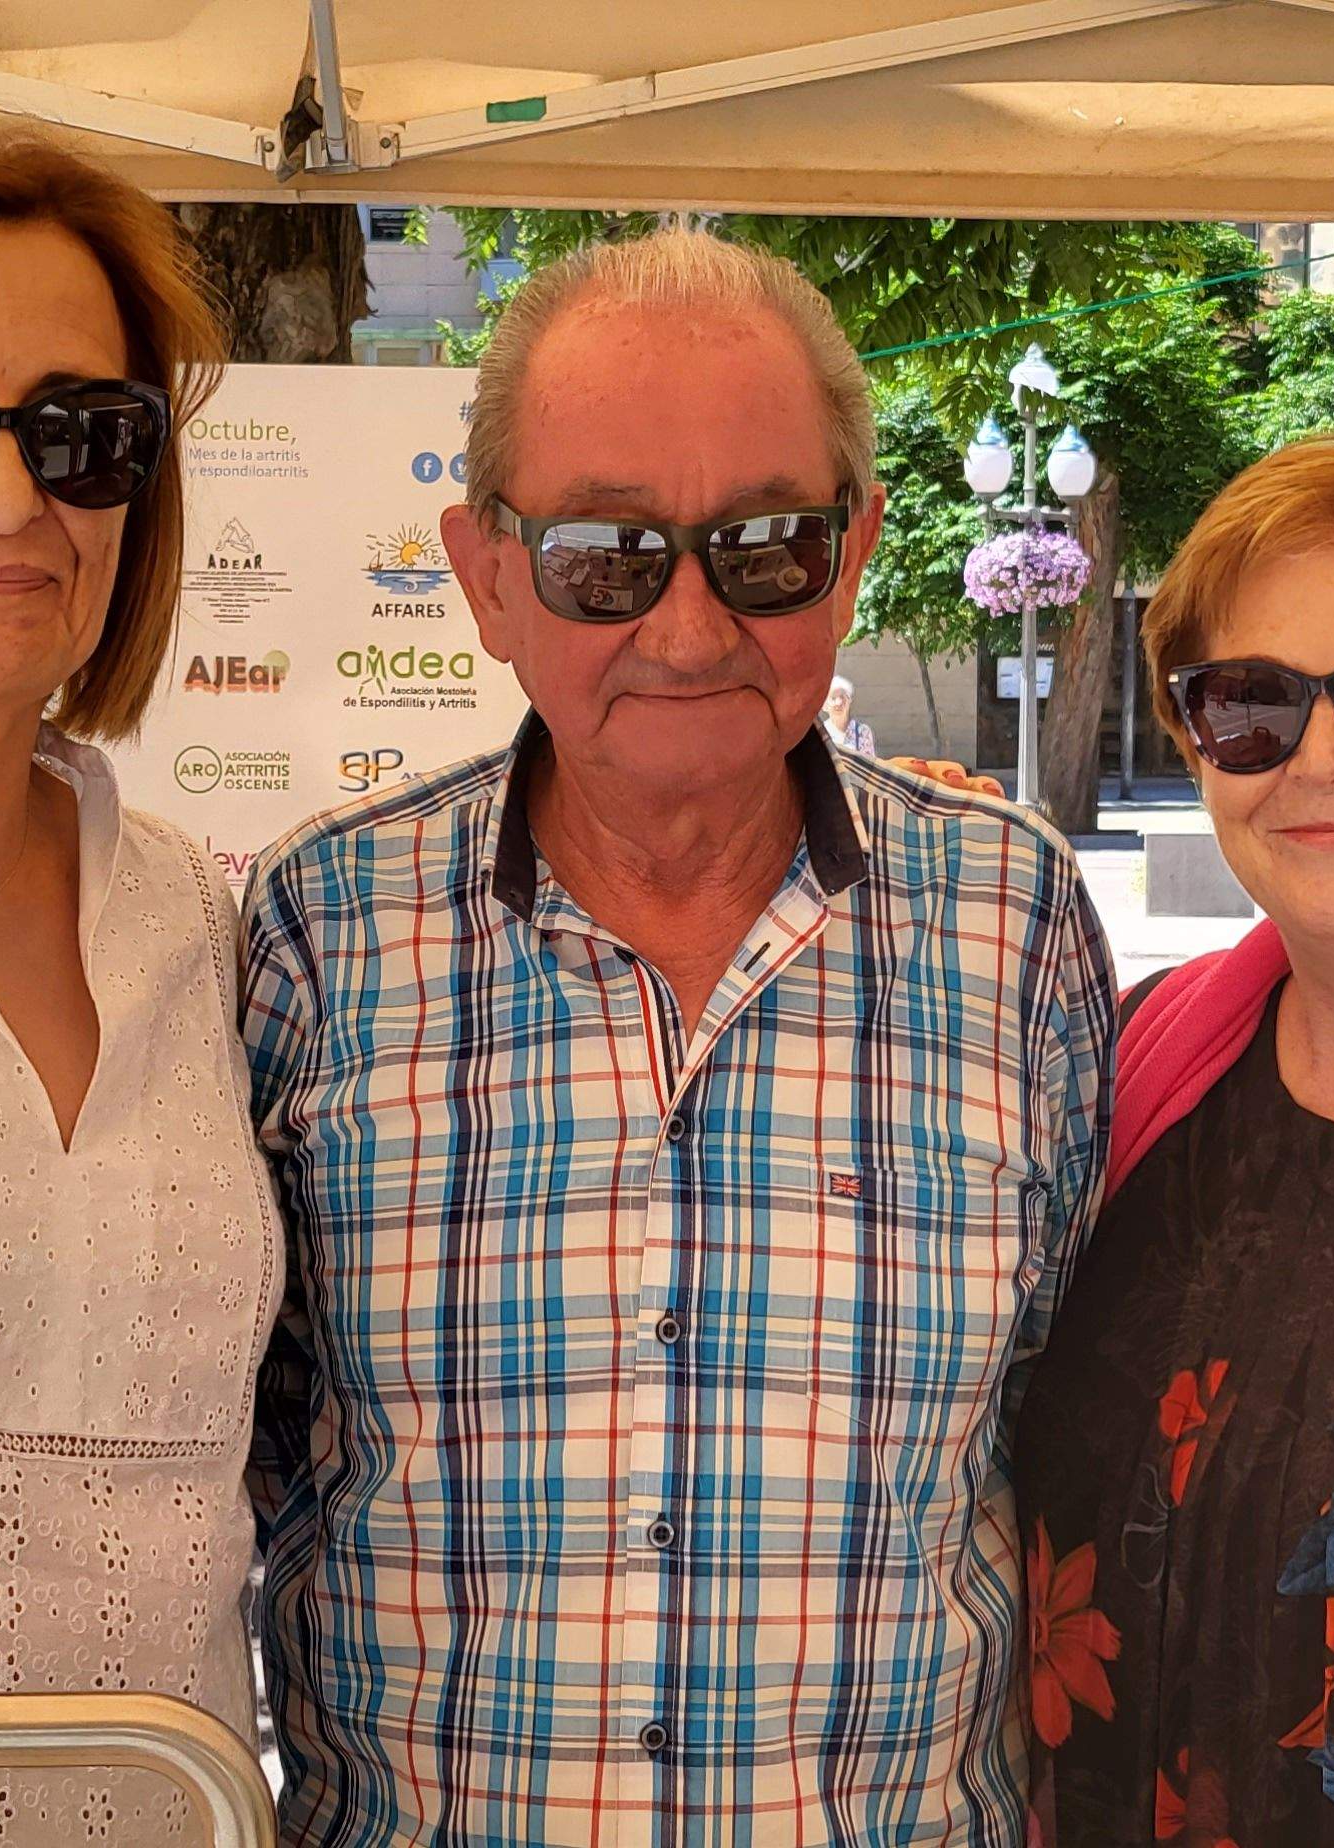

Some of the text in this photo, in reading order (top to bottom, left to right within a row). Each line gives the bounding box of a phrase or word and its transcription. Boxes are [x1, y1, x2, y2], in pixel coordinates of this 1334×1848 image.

[188, 418, 297, 446] Octubre,
[188, 447, 301, 462] Mes de la artritis
[188, 464, 309, 479] y espondiloartritis
[207, 553, 263, 570] ADEAR
[371, 602, 446, 619] AFFARES
[390, 686, 435, 696] Asociación
[343, 696, 477, 710] de Espondilitis y Artritis
[224, 751, 291, 762] ASOCIACIÓN
[179, 763, 291, 778] ARO ARTRITIS
[224, 778, 291, 791] OSCENSE
